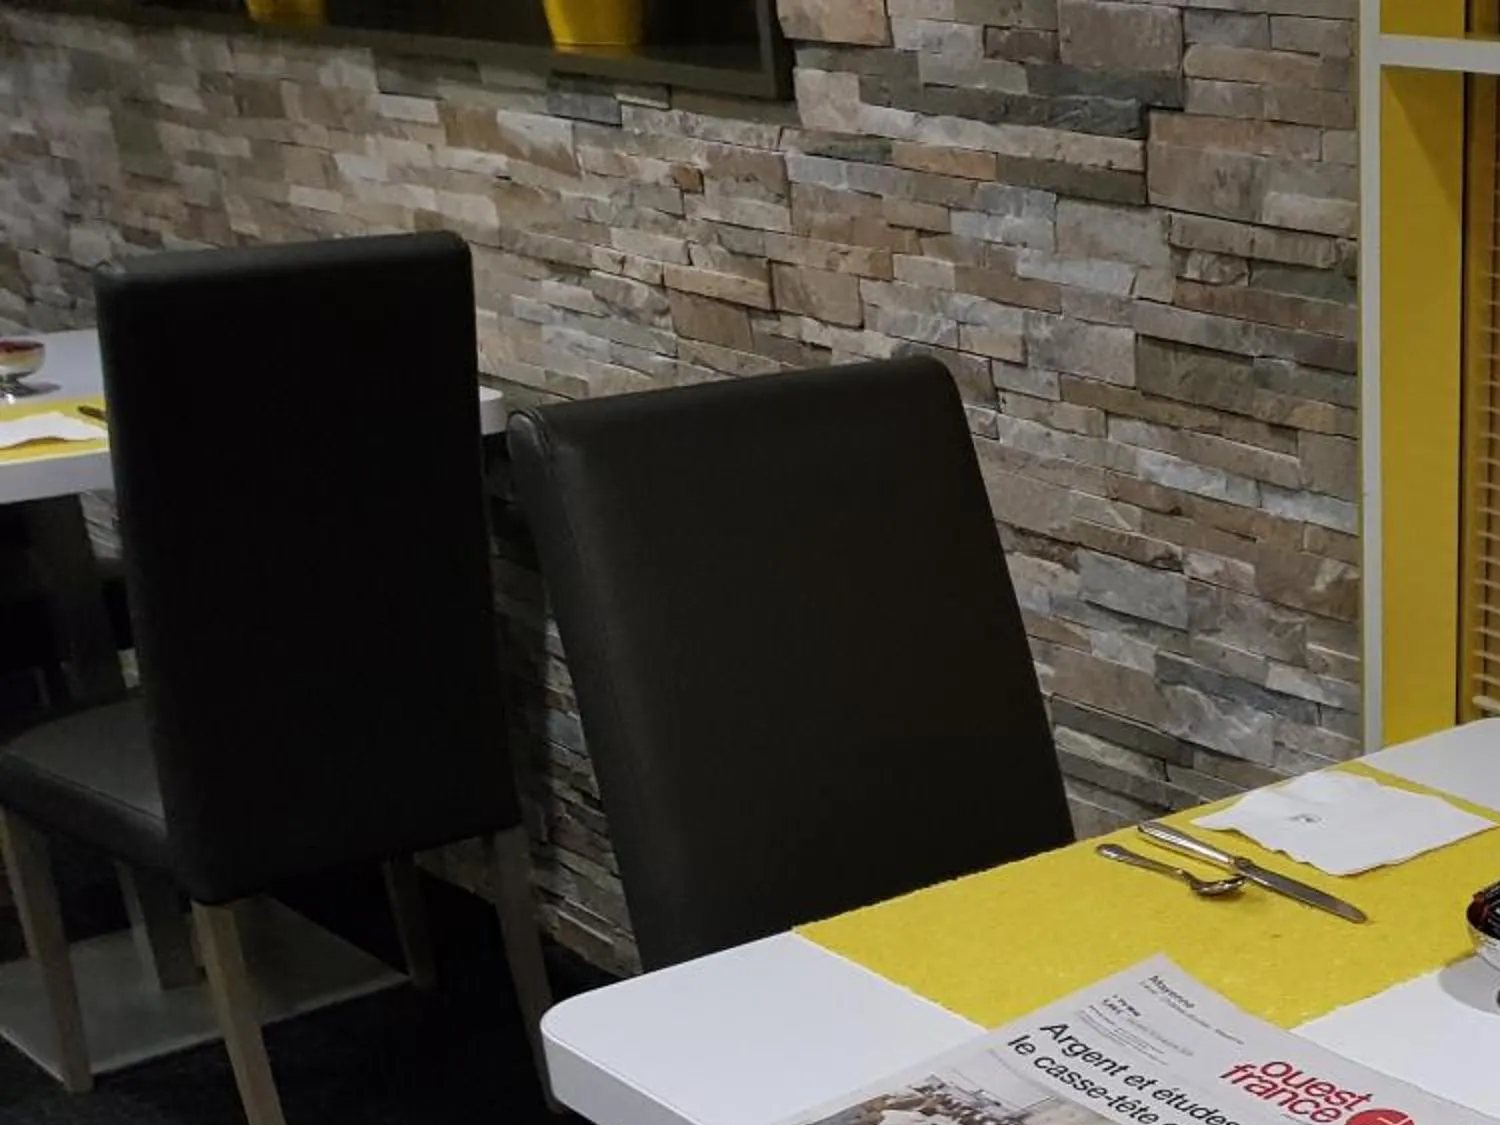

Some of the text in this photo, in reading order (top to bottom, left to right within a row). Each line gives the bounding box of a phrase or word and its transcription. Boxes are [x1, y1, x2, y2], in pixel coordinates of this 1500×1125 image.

[1007, 1034, 1037, 1056] le
[1033, 1055, 1159, 1125] casse-tête
[1040, 1022, 1128, 1077] Argent
[1124, 1070, 1158, 1092] et
[1260, 1061, 1374, 1112] ouest
[1218, 1063, 1342, 1123] france
